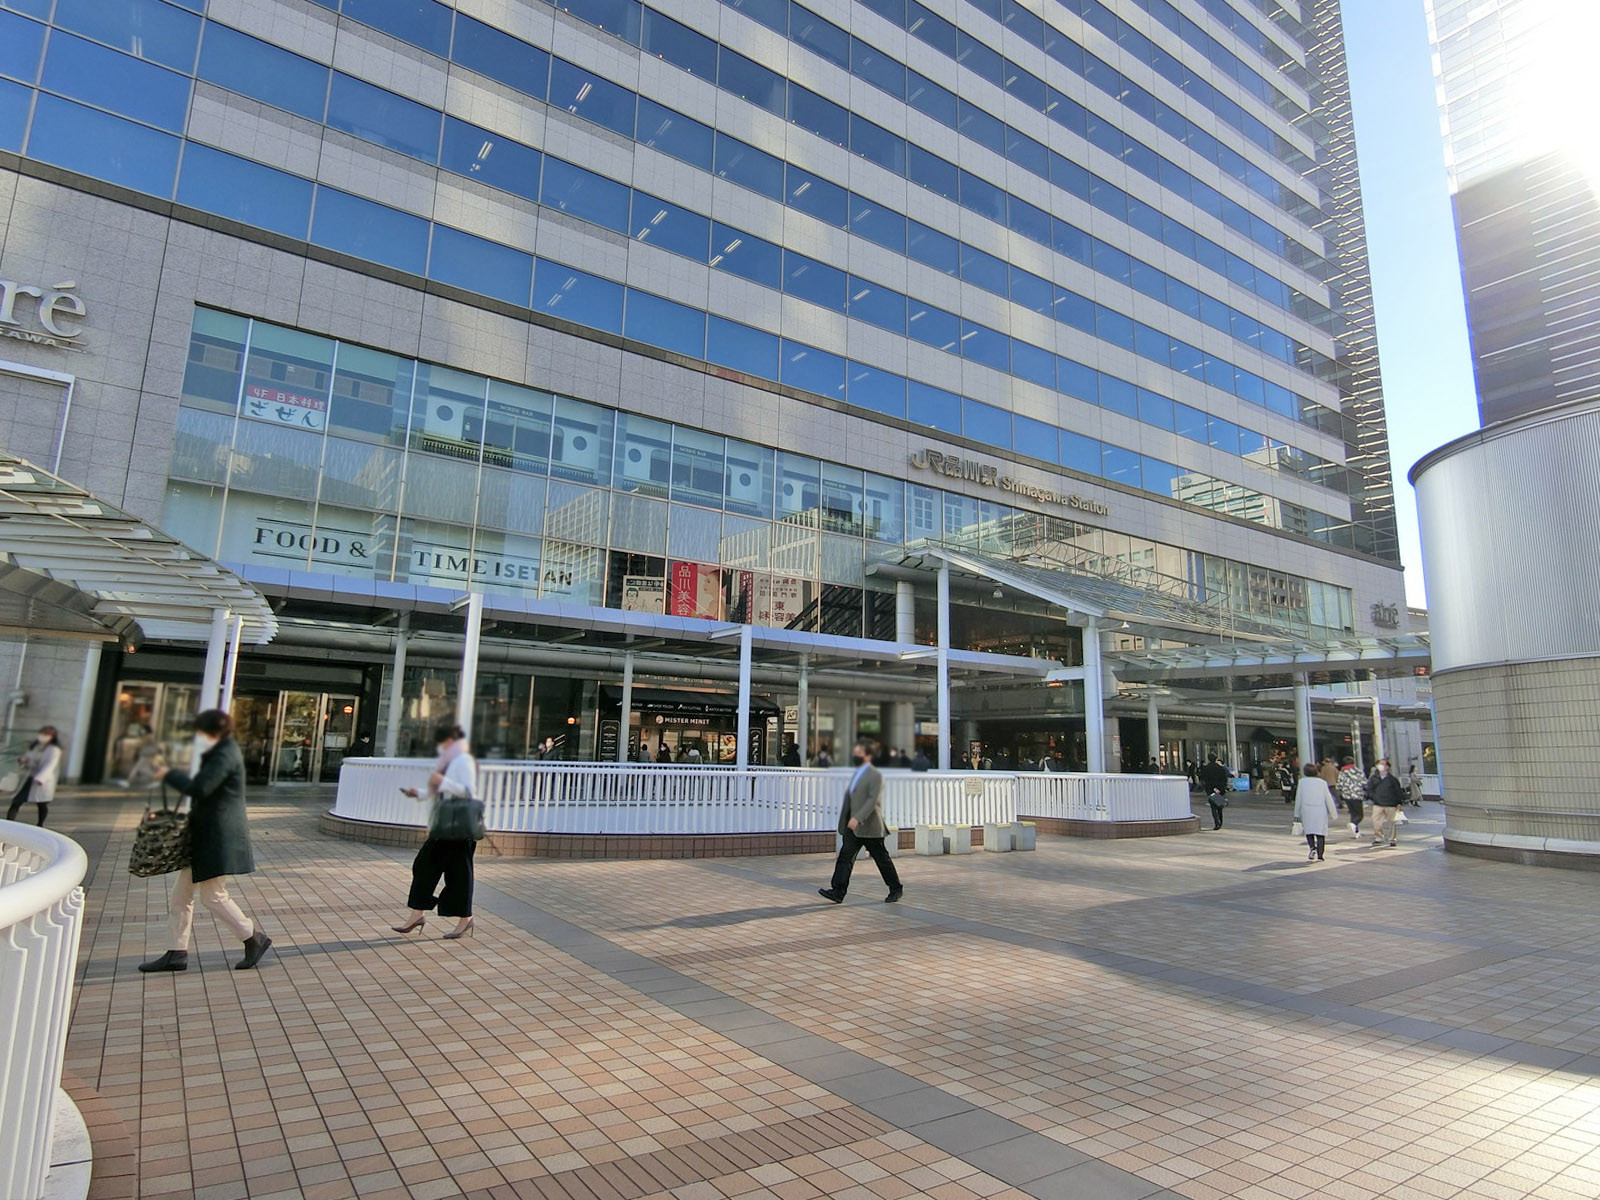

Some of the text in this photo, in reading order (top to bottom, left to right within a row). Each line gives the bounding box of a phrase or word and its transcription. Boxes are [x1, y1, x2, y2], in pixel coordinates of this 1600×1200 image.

[250, 400, 320, 428] ざぜん
[253, 387, 325, 411] 4F 日本料理
[911, 448, 1111, 517] JR品川駅 Shinagawa Station
[253, 527, 369, 559] FOOD &
[413, 550, 573, 586] TIME ISETAN
[677, 565, 691, 616] 品川美容
